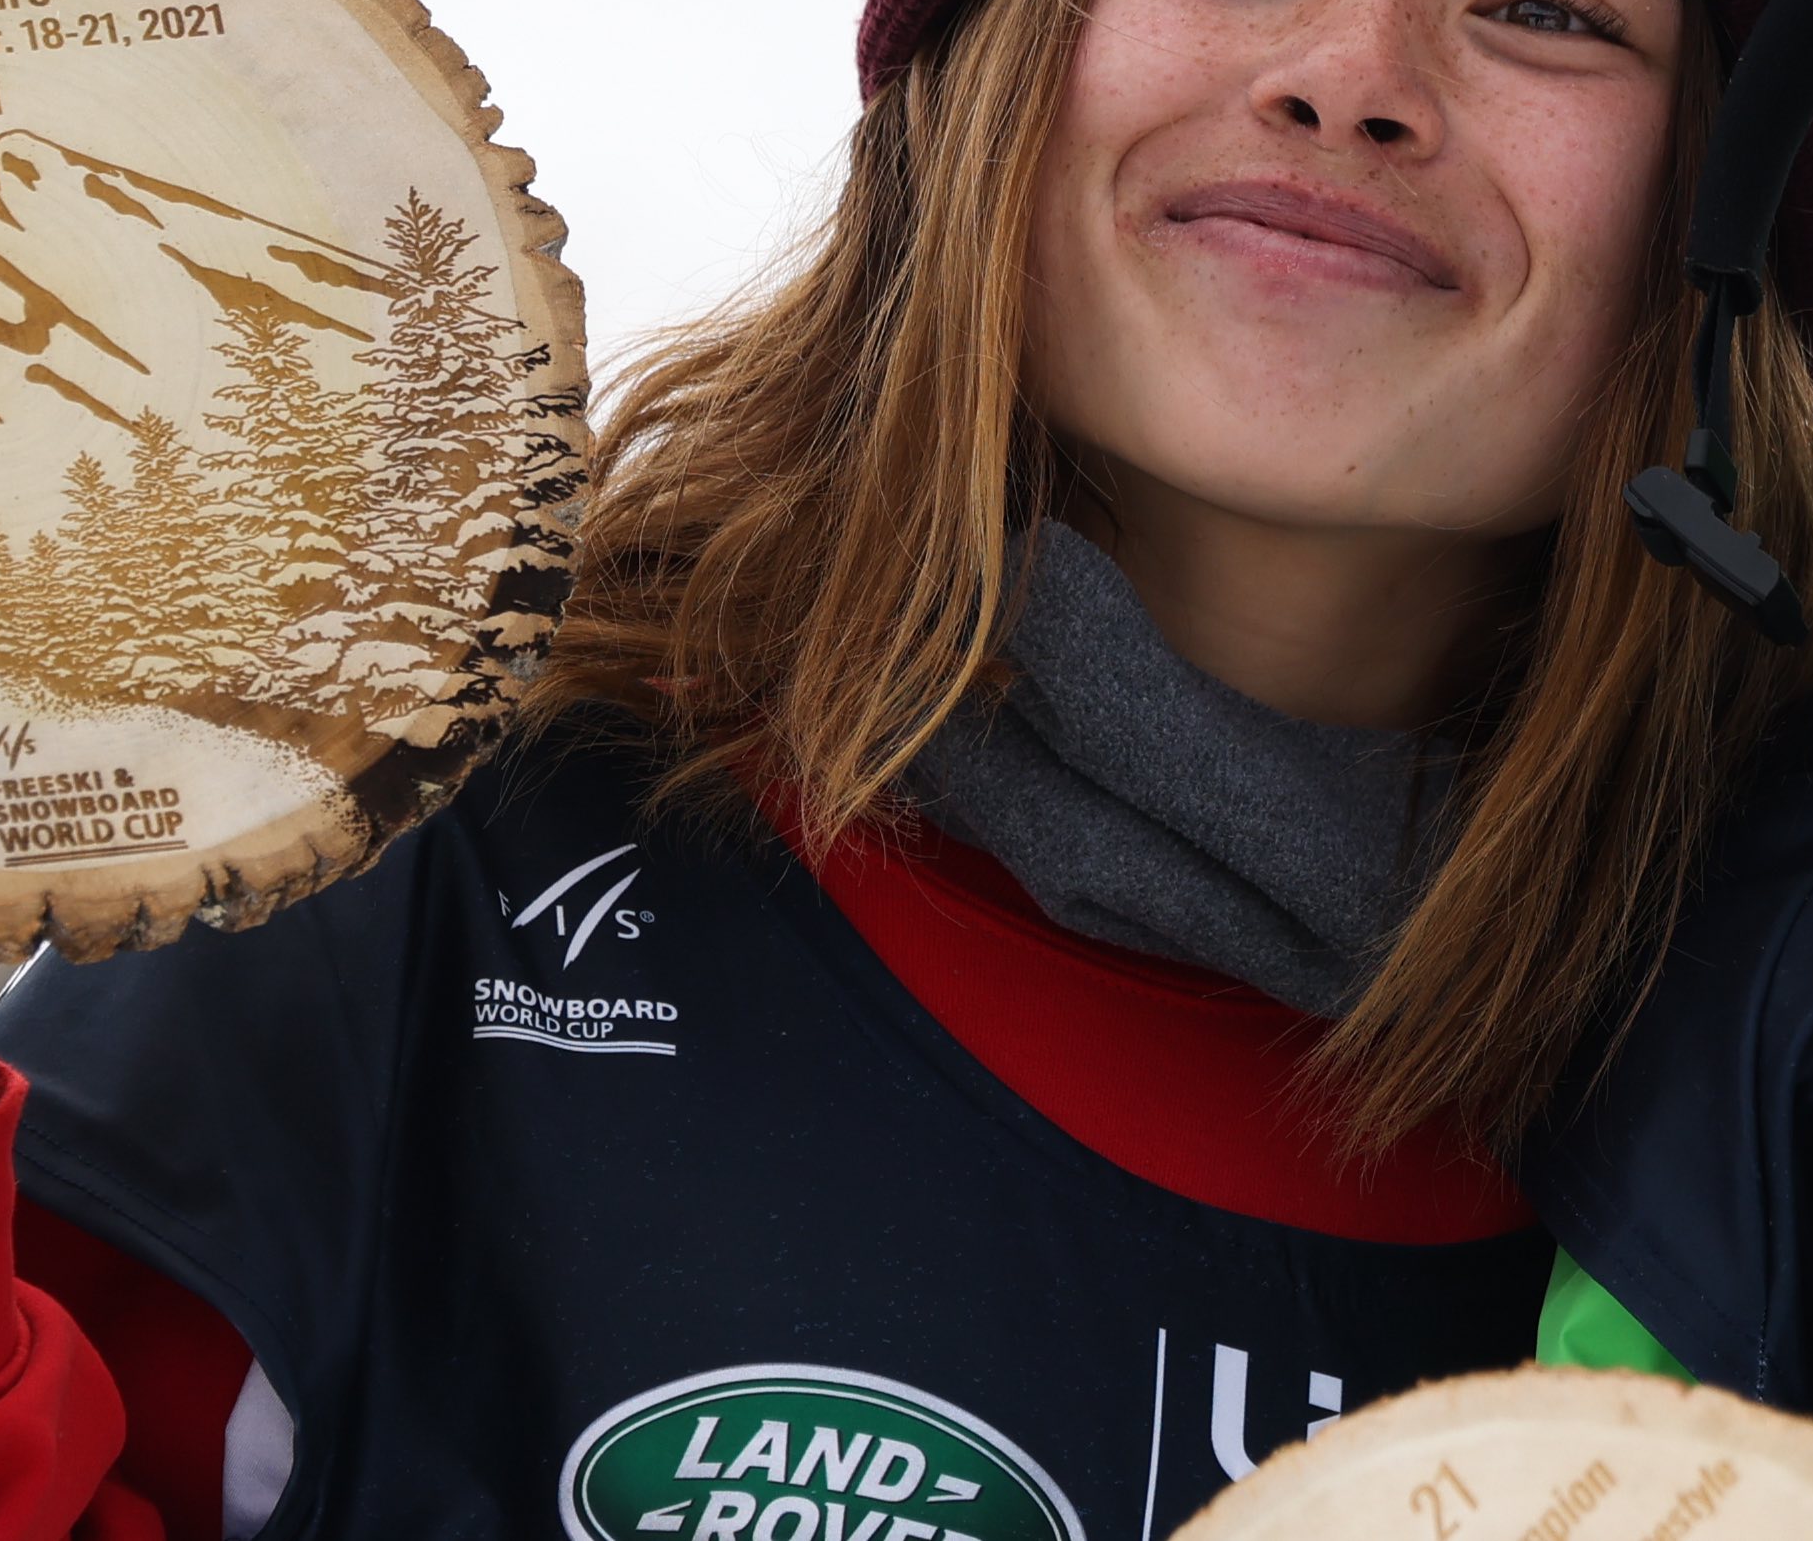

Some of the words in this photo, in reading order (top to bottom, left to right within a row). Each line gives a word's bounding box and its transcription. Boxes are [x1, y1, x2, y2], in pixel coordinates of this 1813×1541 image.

[19, 12, 131, 53] 18-21,
[137, 3, 226, 42] 2021
[113, 768, 134, 789] &
[124, 811, 184, 840] CUP
[474, 978, 678, 1021] SNOWBOARD
[475, 1003, 561, 1033] WORLD
[567, 1020, 614, 1039] CUP
[673, 1416, 927, 1503] LAND
